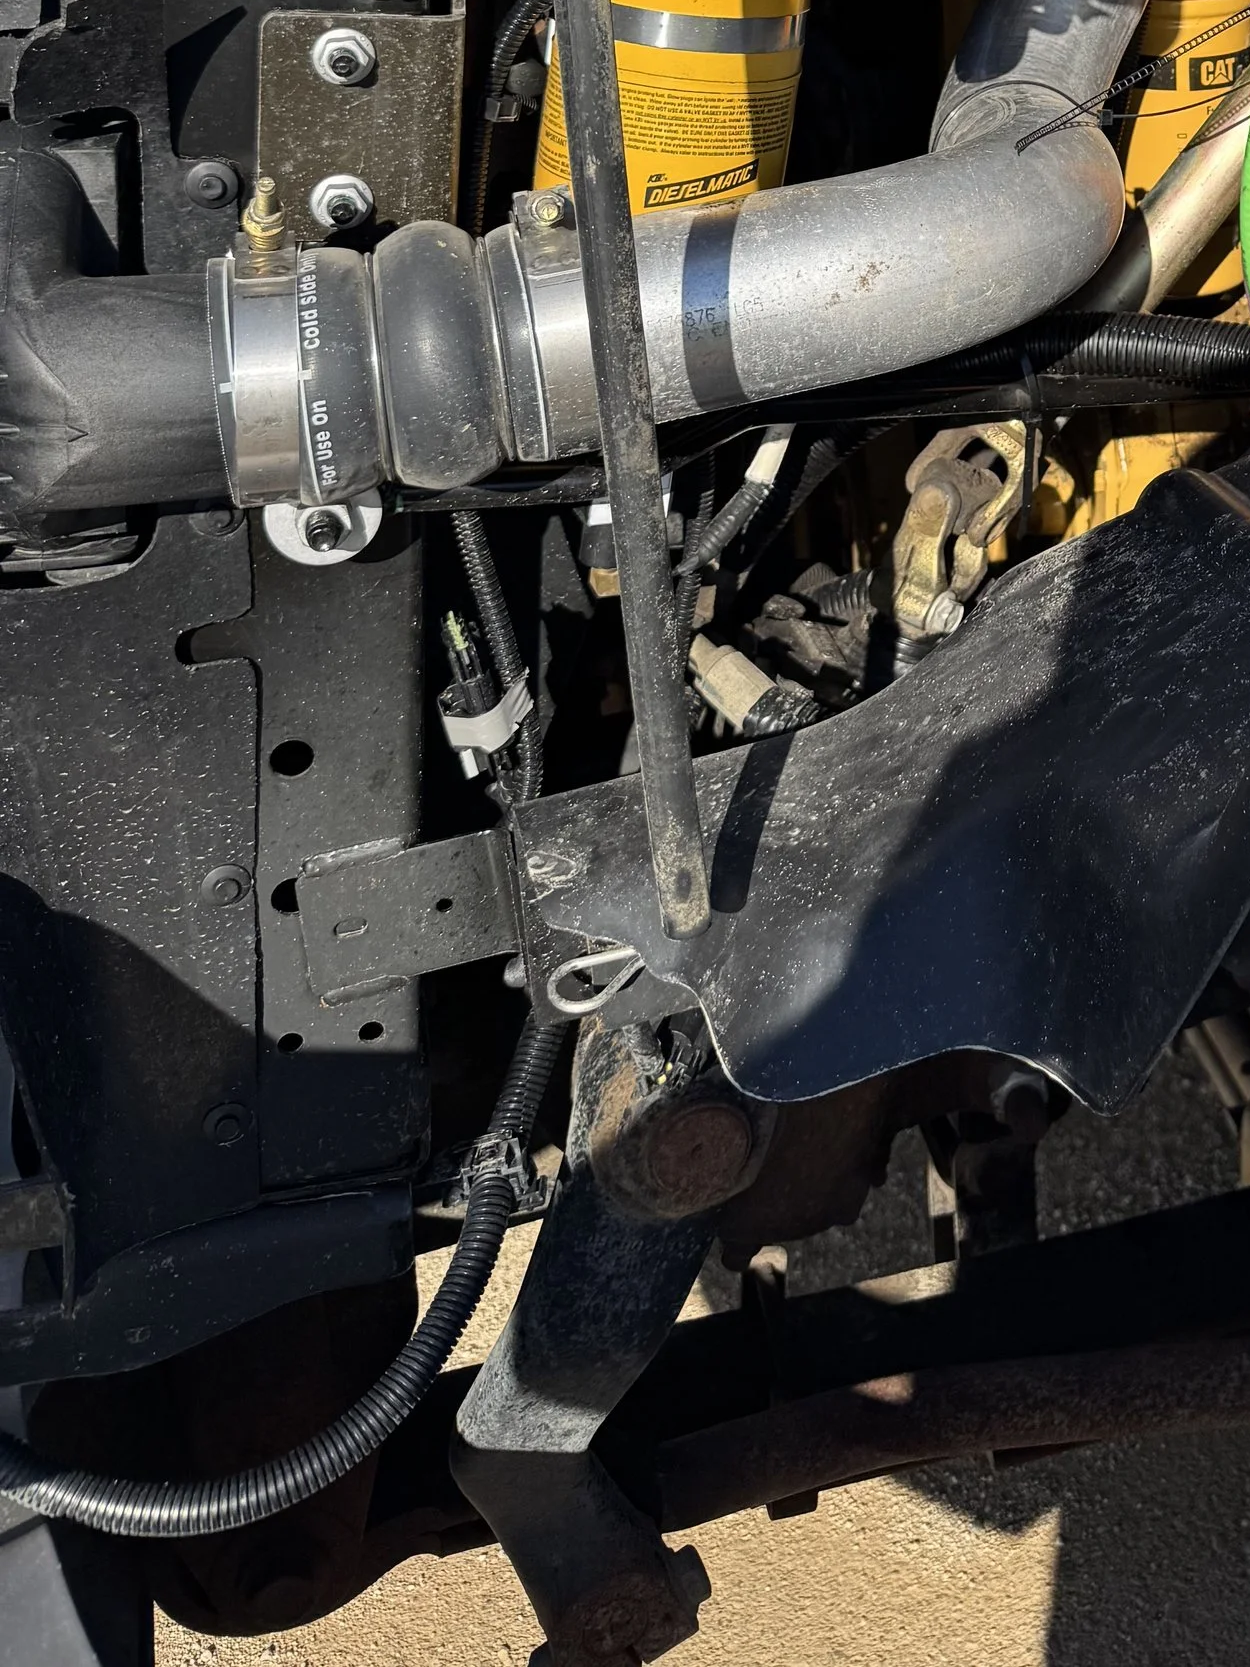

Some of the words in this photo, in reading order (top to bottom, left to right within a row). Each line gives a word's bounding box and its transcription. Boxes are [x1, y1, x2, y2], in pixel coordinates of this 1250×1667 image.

[1200, 57, 1235, 86] CAT
[647, 164, 754, 206] DIESELMATIC
[301, 308, 321, 351] Cold
[315, 430, 333, 462] Use
[322, 464, 338, 487] For
